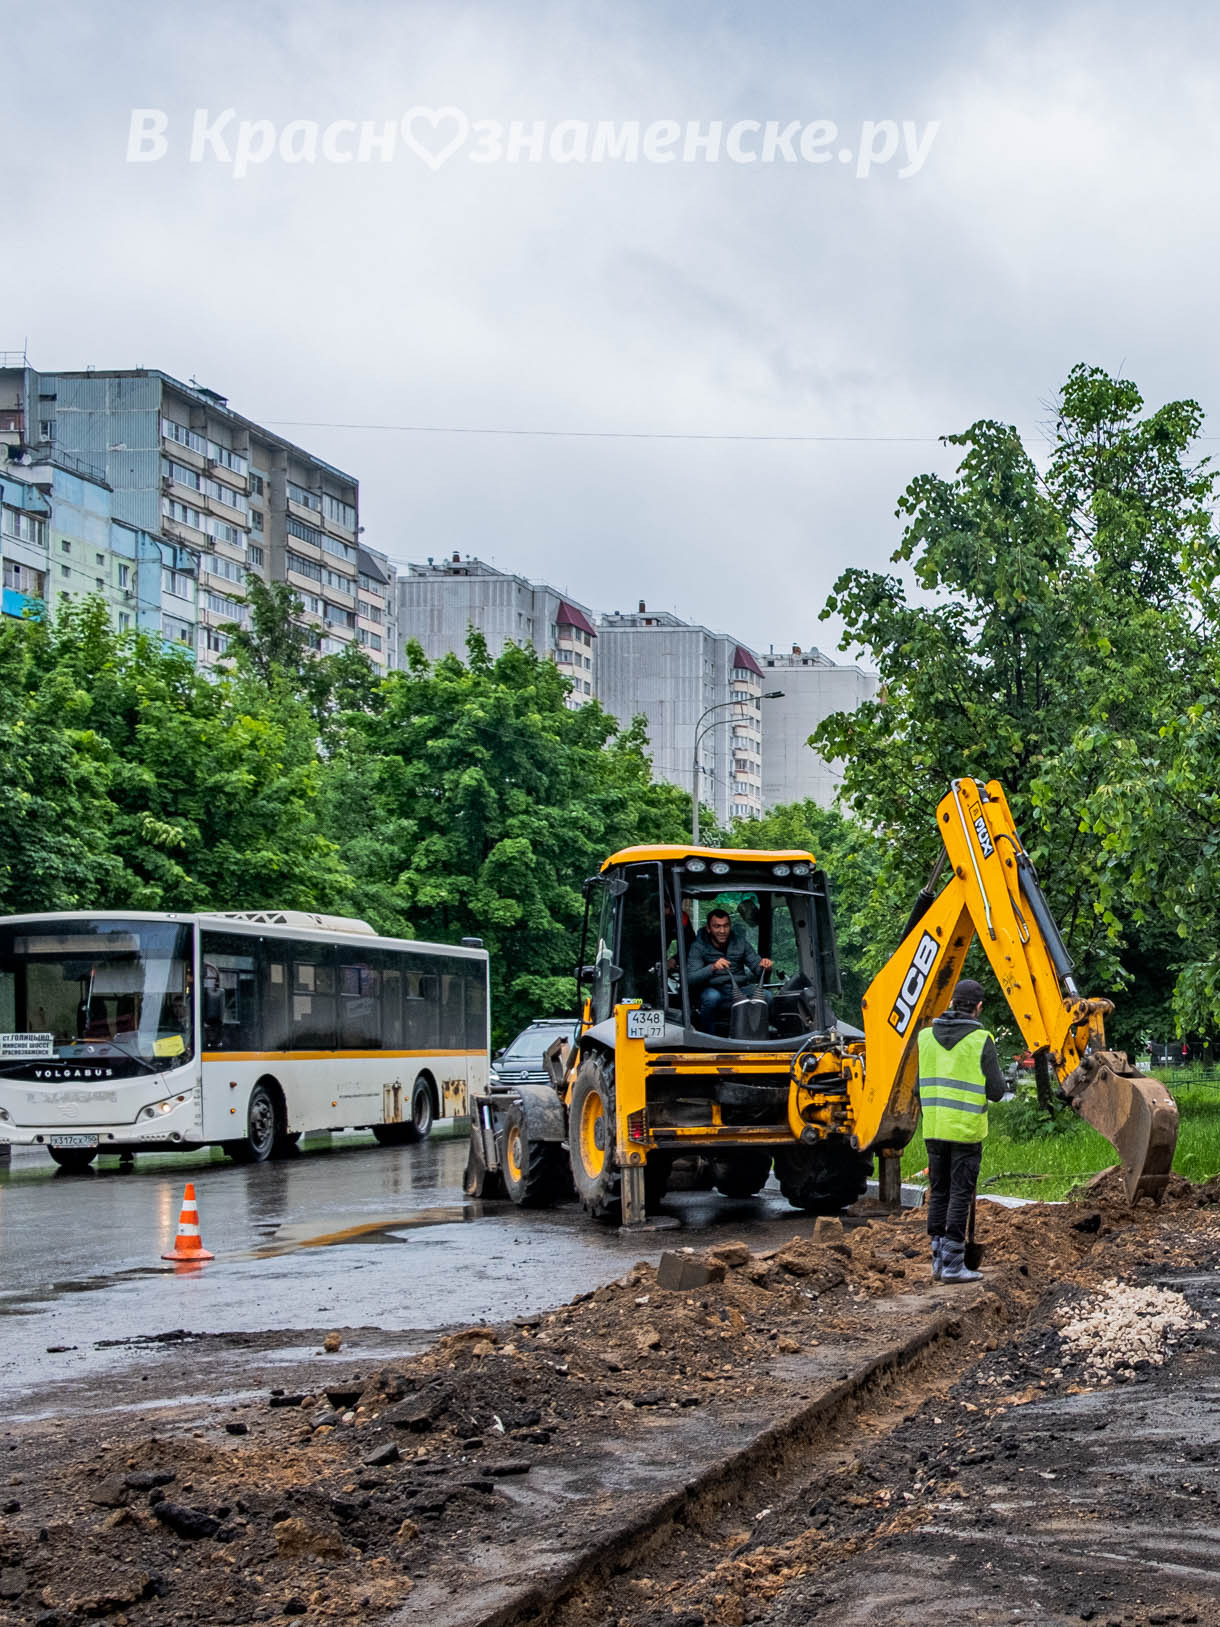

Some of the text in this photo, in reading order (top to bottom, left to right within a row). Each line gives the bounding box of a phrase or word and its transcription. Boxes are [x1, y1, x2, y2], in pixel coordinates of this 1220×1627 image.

[895, 934, 938, 1033] JCB
[632, 1013, 660, 1024] 4348
[650, 1027, 661, 1036] 77
[35, 1069, 112, 1078] VOLGABUS
